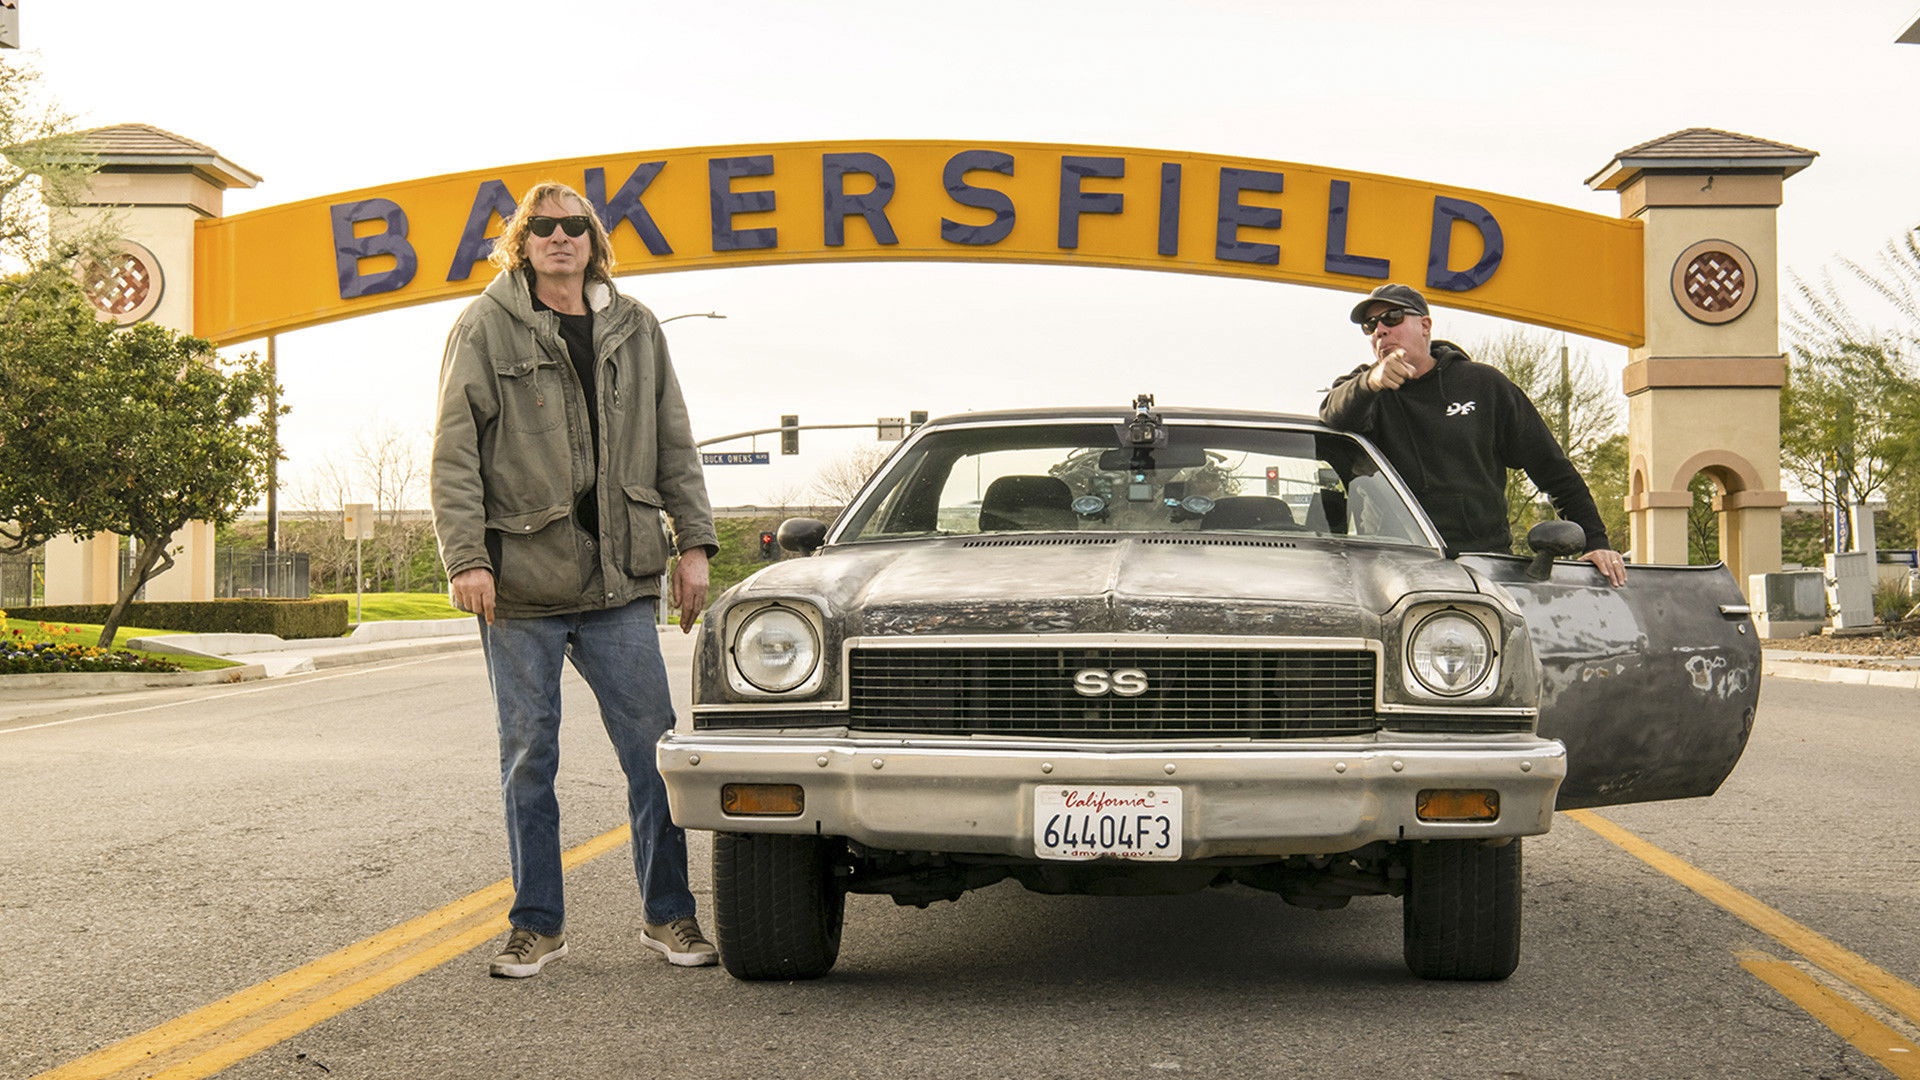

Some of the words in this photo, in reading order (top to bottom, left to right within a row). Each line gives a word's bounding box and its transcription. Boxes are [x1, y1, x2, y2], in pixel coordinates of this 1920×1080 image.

[330, 151, 1504, 299] BAKERSFIELD
[704, 454, 723, 464] BUCK
[727, 454, 753, 463] OWENS
[1073, 668, 1149, 697] SS
[1065, 790, 1155, 813] California
[1044, 814, 1170, 849] 64404F3
